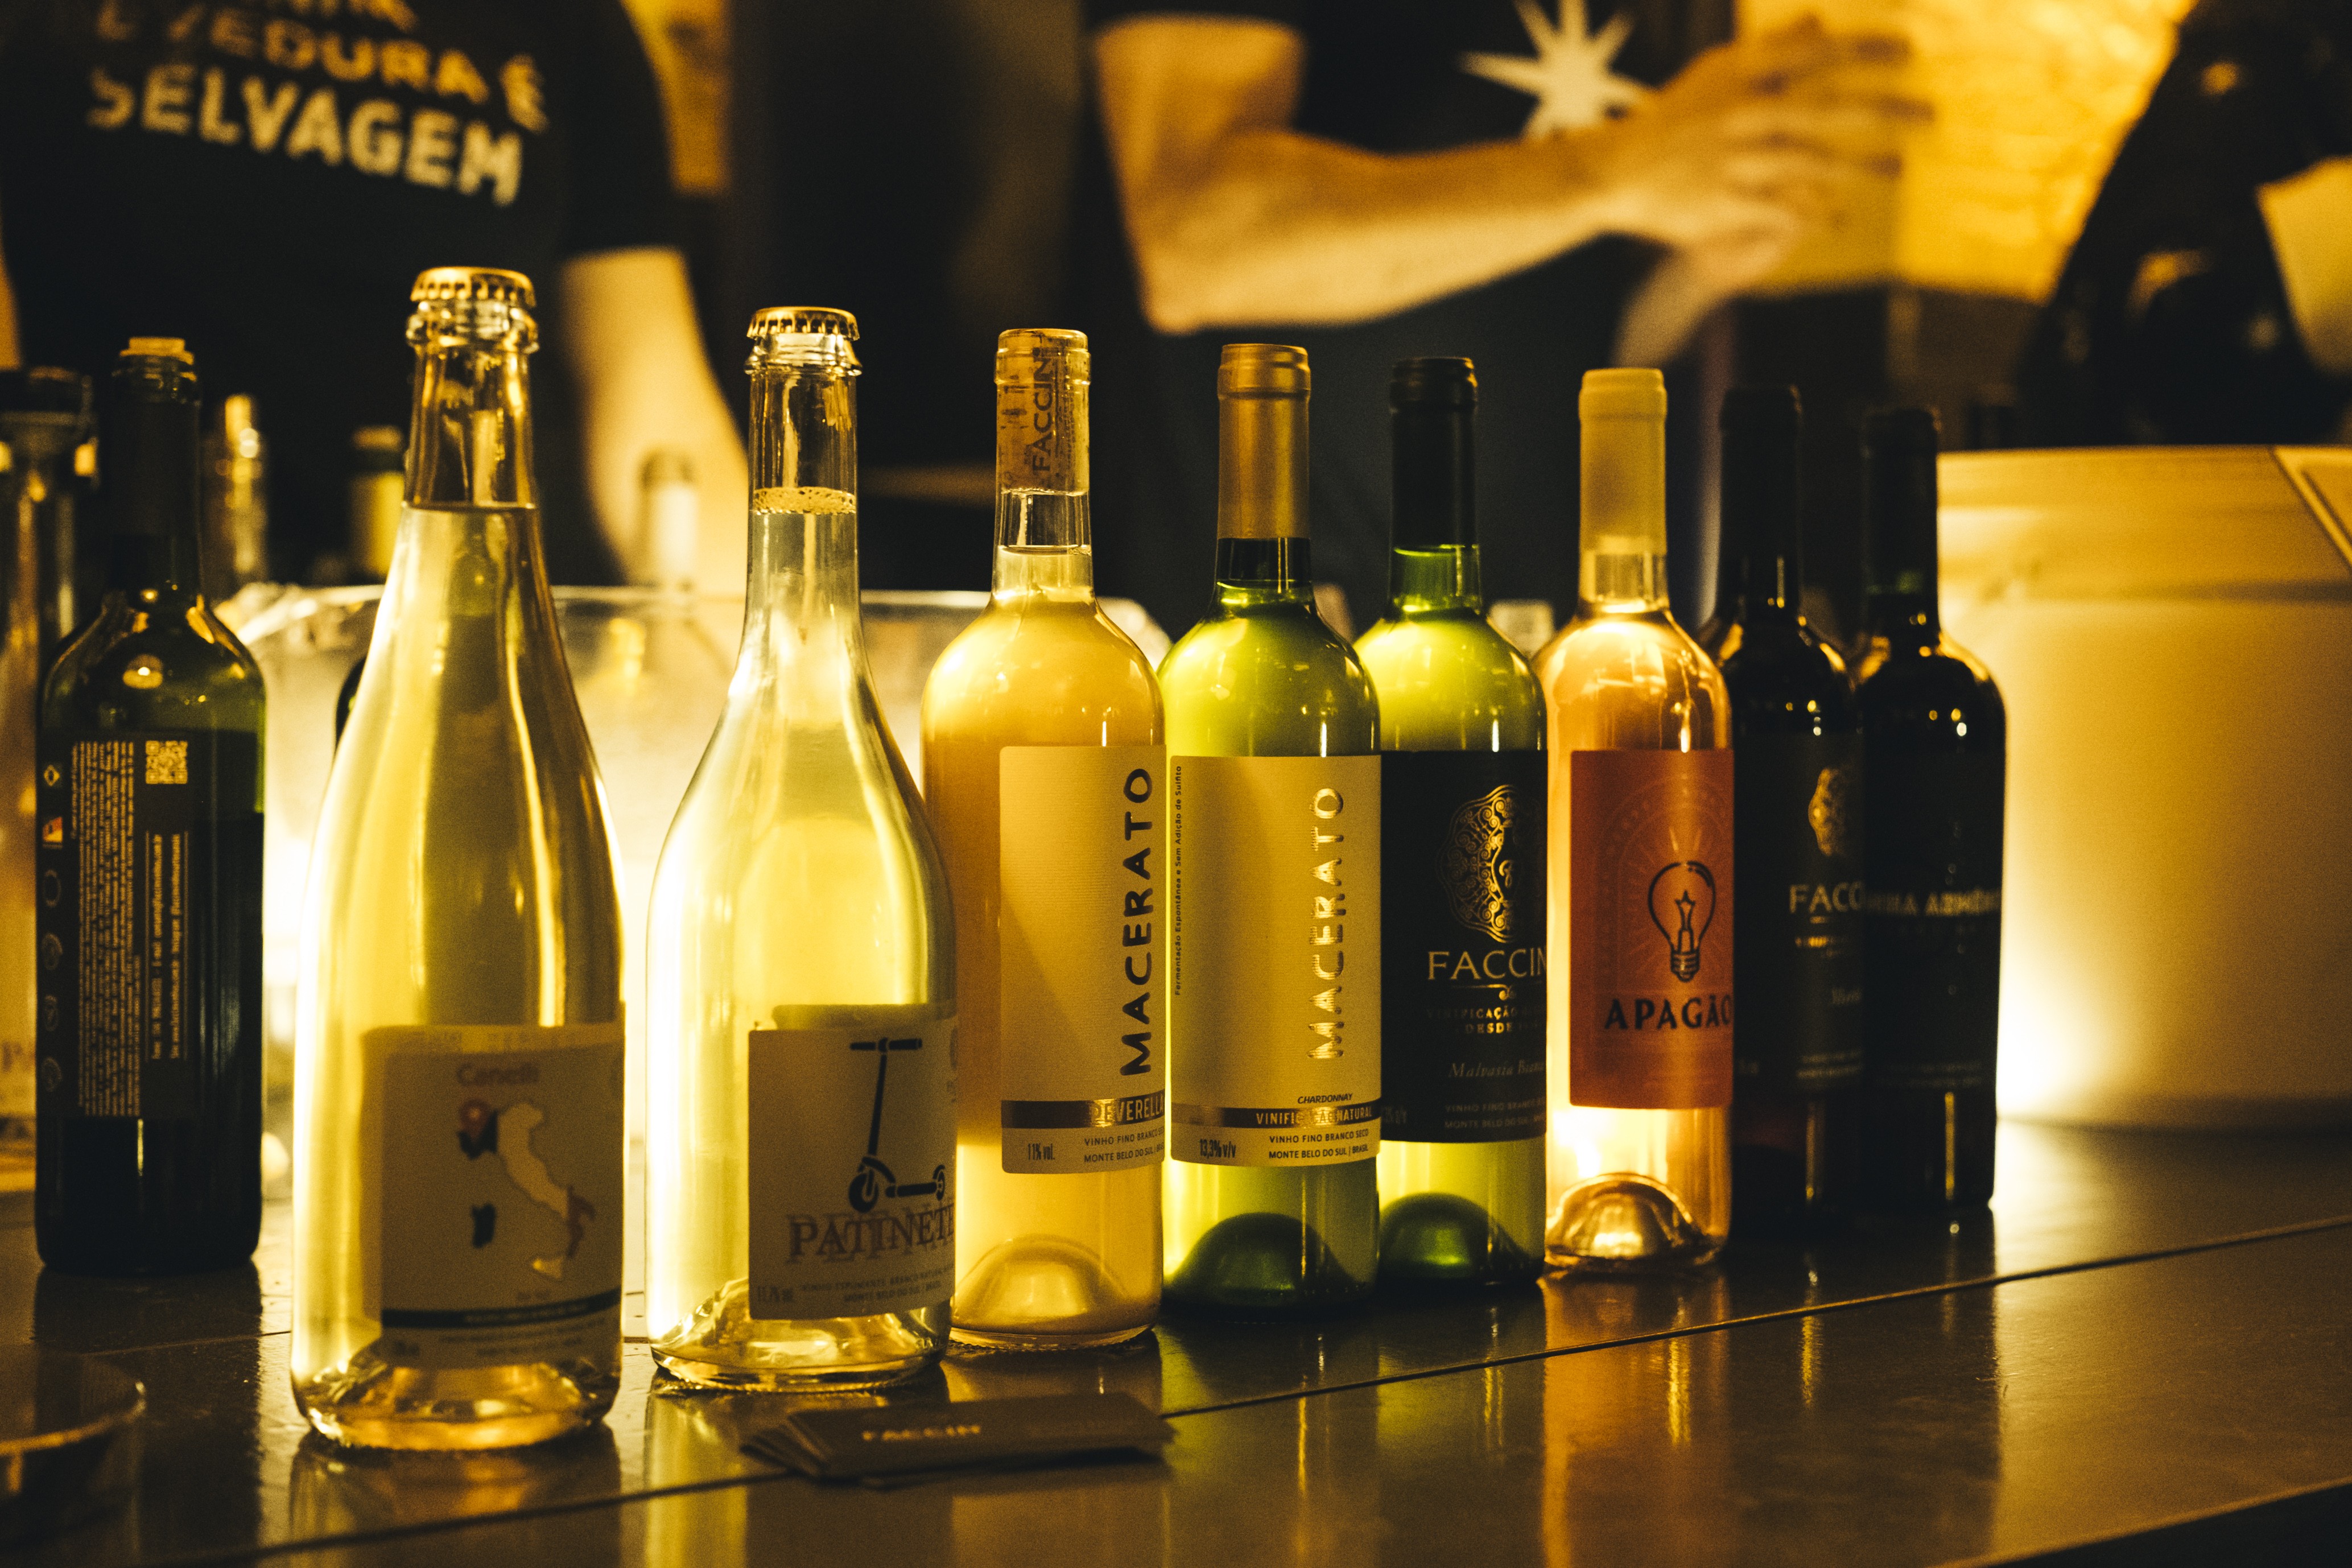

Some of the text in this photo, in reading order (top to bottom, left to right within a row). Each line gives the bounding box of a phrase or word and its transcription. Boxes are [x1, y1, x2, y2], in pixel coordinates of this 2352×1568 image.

[88, 64, 523, 207] SELVAGEM
[1174, 798, 1182, 810] de
[1174, 813, 1183, 845] Adição
[1174, 878, 1183, 932] Espontânea
[1120, 769, 1153, 1076] MACERATO
[1307, 787, 1346, 1059] MACERATO
[1174, 934, 1183, 996] Fermentação
[1604, 994, 1732, 1030] APAGÃO
[1297, 1094, 1352, 1104] CHARDONNAY
[1336, 1106, 1372, 1121] NATURAL
[1084, 1136, 1114, 1146] VINHO
[1117, 1134, 1134, 1144] FINO
[1269, 1128, 1369, 1144] VINHO FINO BRANCO SECO
[1084, 1153, 1115, 1162] MONTE
[1117, 1151, 1133, 1160] BELO
[1135, 1148, 1144, 1157] DO
[1269, 1144, 1368, 1159] MONTE BELO DO SUL BRASIL
